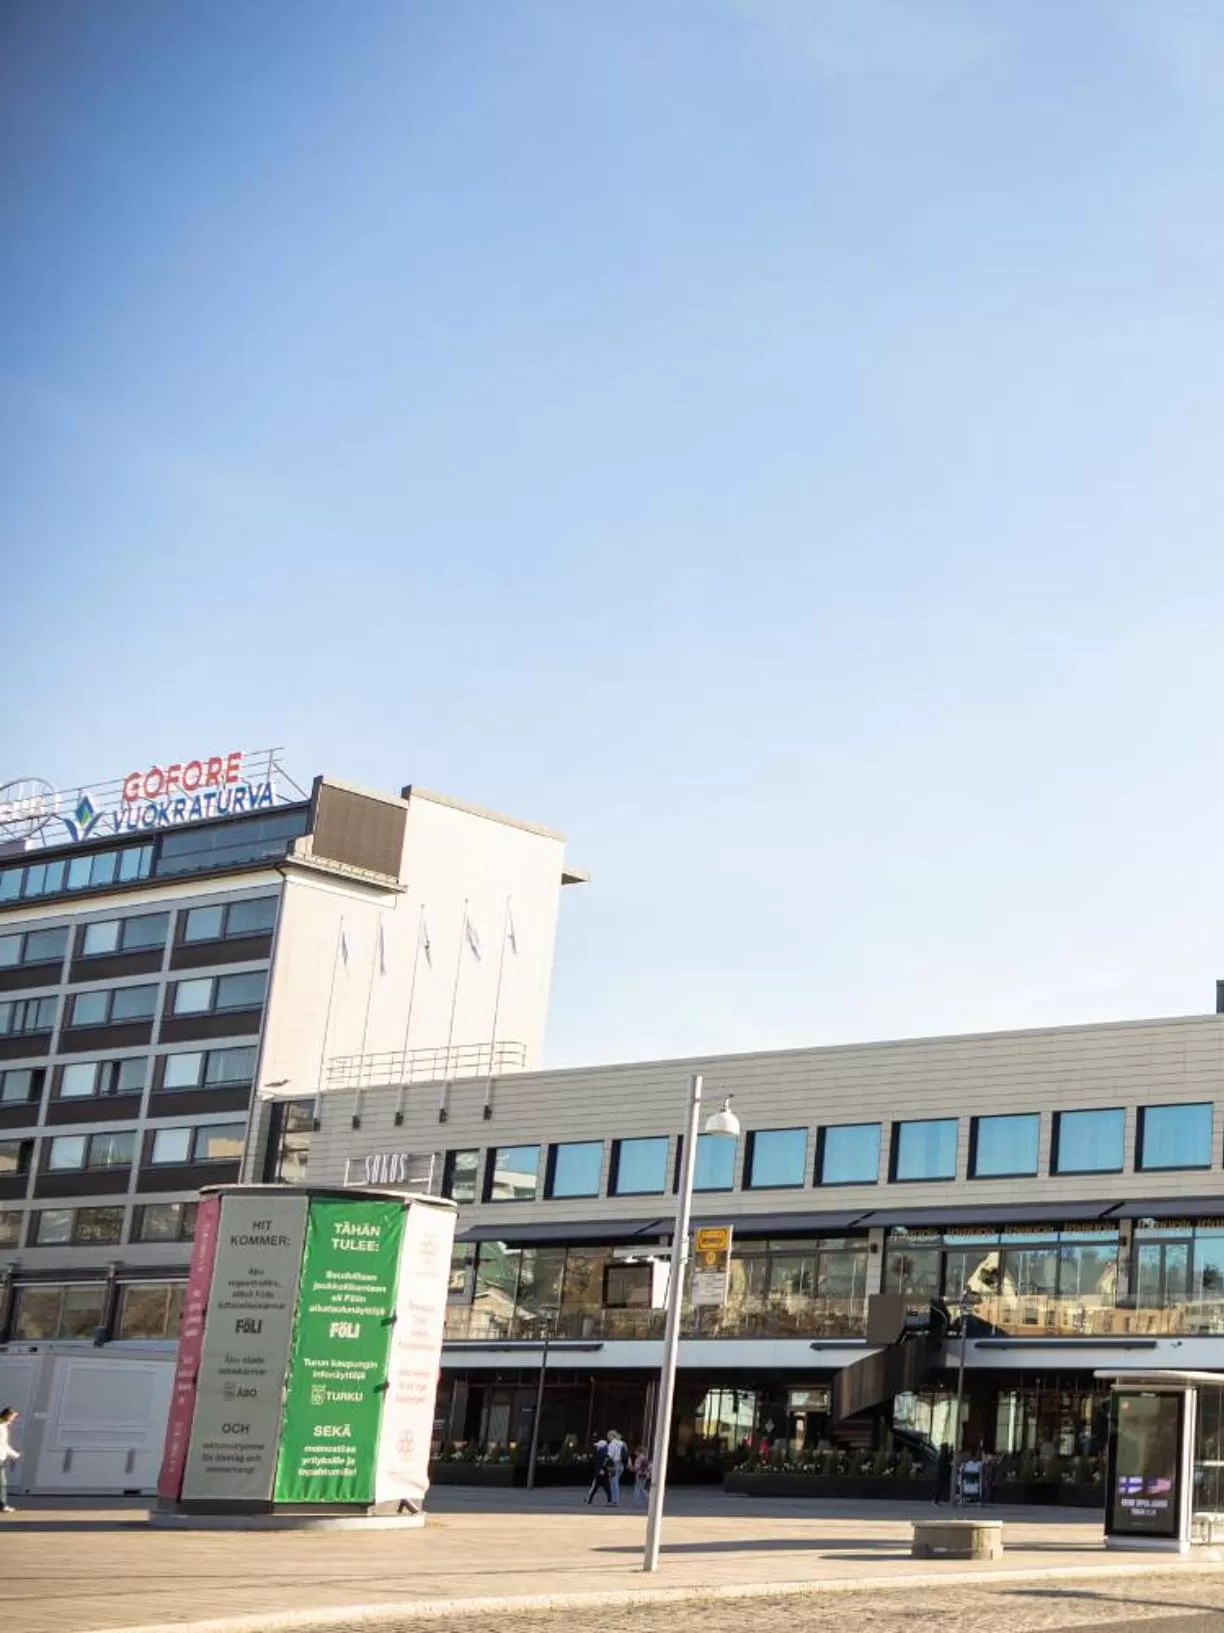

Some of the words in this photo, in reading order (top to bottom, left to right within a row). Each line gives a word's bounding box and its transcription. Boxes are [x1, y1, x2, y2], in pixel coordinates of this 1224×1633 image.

[122, 751, 243, 802] GOFORE
[112, 781, 275, 833] VUOKRATURVA
[252, 1220, 273, 1231] HIT
[333, 1221, 381, 1237] TÄHÄN
[230, 1235, 291, 1247] KOMMER:
[331, 1238, 380, 1252] TULEE:
[326, 1391, 363, 1402] TURKU
[222, 1423, 250, 1434] OCH
[313, 1424, 352, 1437] SEKÄ
